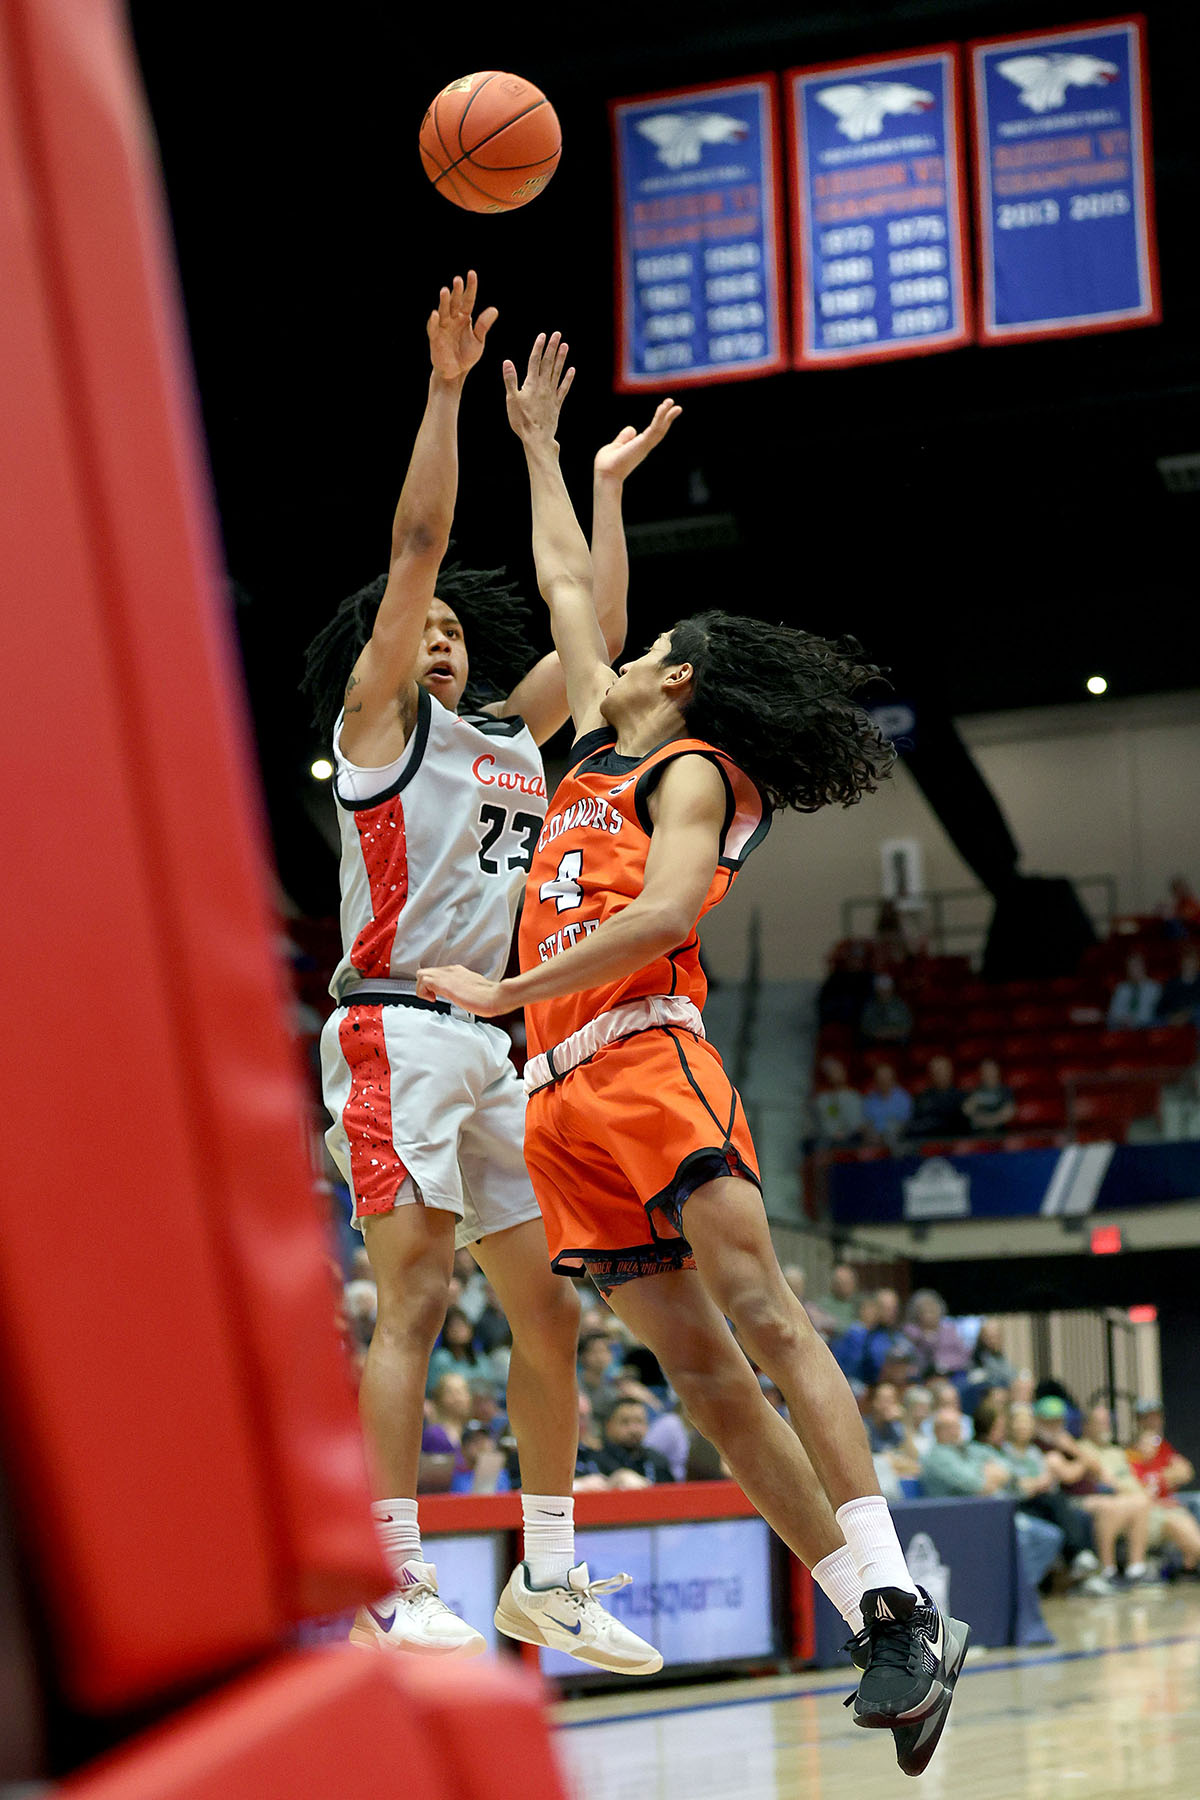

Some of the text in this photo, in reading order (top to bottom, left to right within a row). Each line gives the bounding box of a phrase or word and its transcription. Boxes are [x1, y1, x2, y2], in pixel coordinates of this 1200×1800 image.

[477, 803, 545, 875] 23
[537, 797, 624, 854] CONNORS
[539, 849, 584, 915] 4
